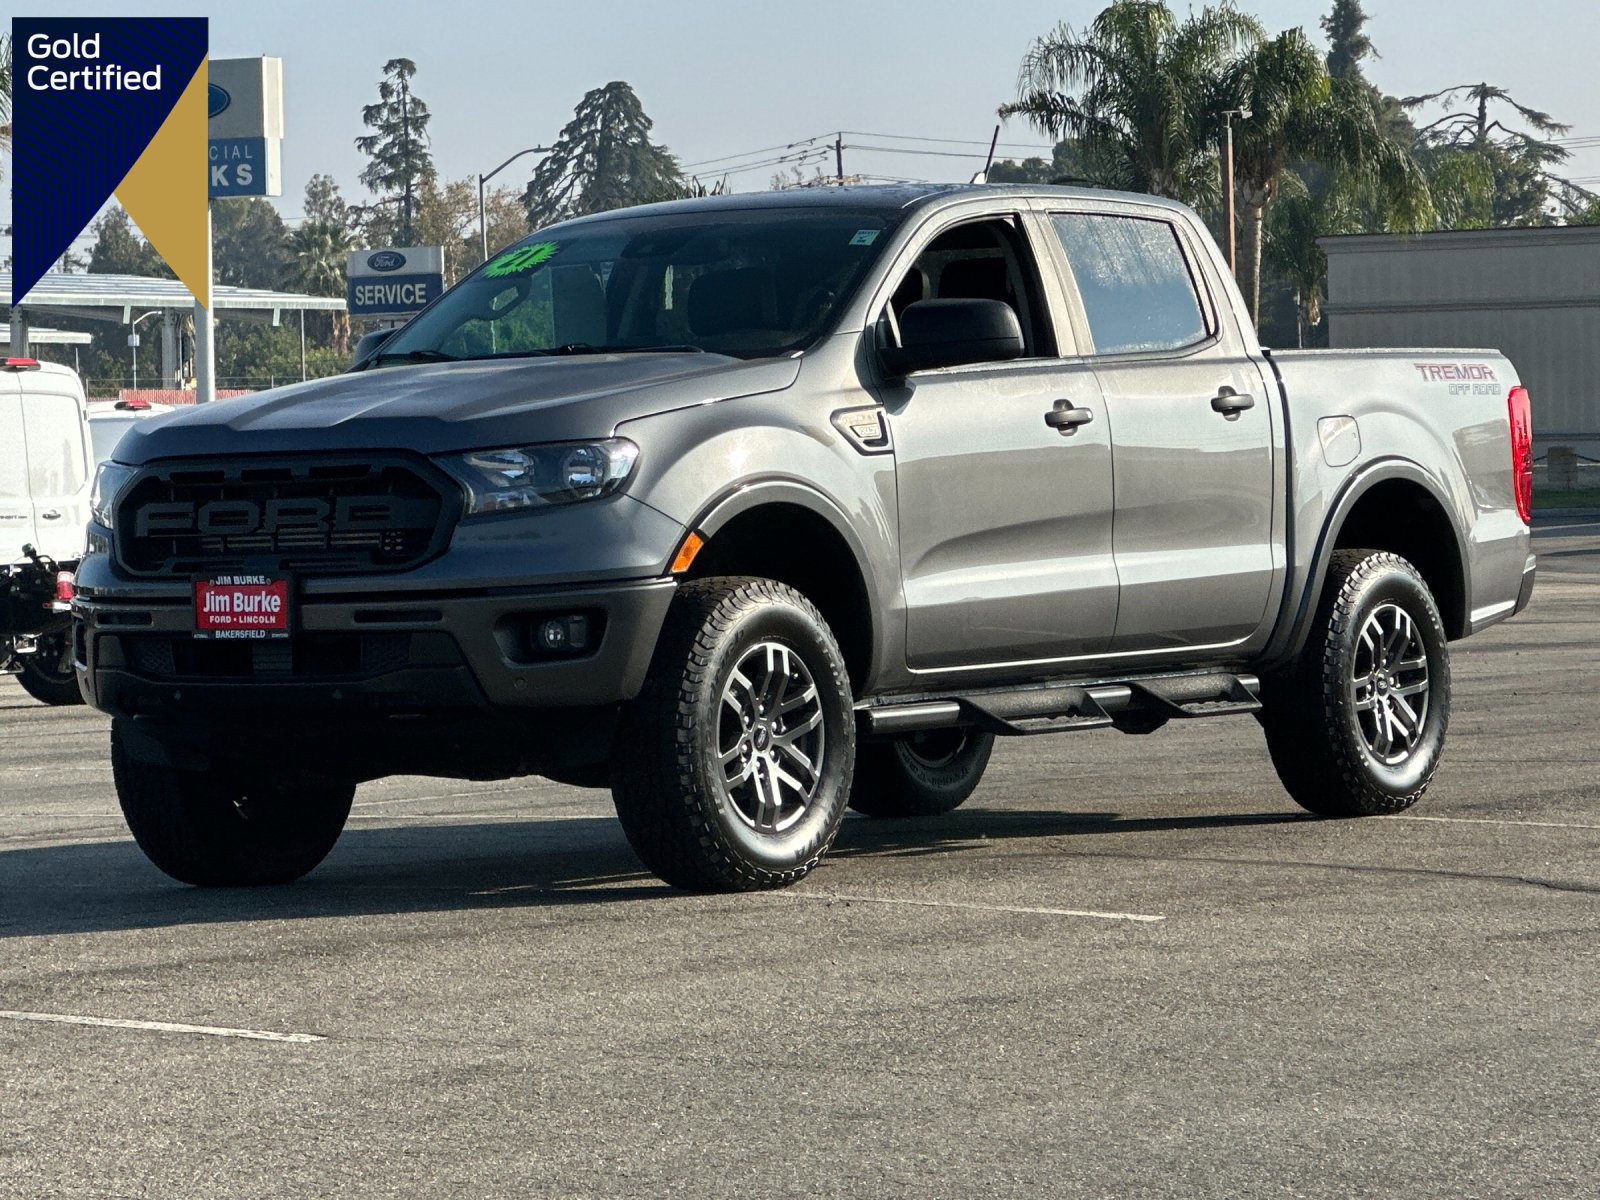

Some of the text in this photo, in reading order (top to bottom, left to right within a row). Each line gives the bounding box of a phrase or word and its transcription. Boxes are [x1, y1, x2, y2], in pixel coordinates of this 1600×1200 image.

[373, 256, 395, 268] Ford
[355, 284, 427, 306] SERVICE
[1414, 363, 1498, 382] TREMOR
[1449, 383, 1501, 395] OFF ROAD
[135, 494, 404, 538] FORD
[215, 575, 266, 585] JIM BURKE
[203, 591, 281, 613] Jim Burke
[238, 615, 276, 623] LINCOLN
[215, 630, 266, 639] BAKERSFIELD
